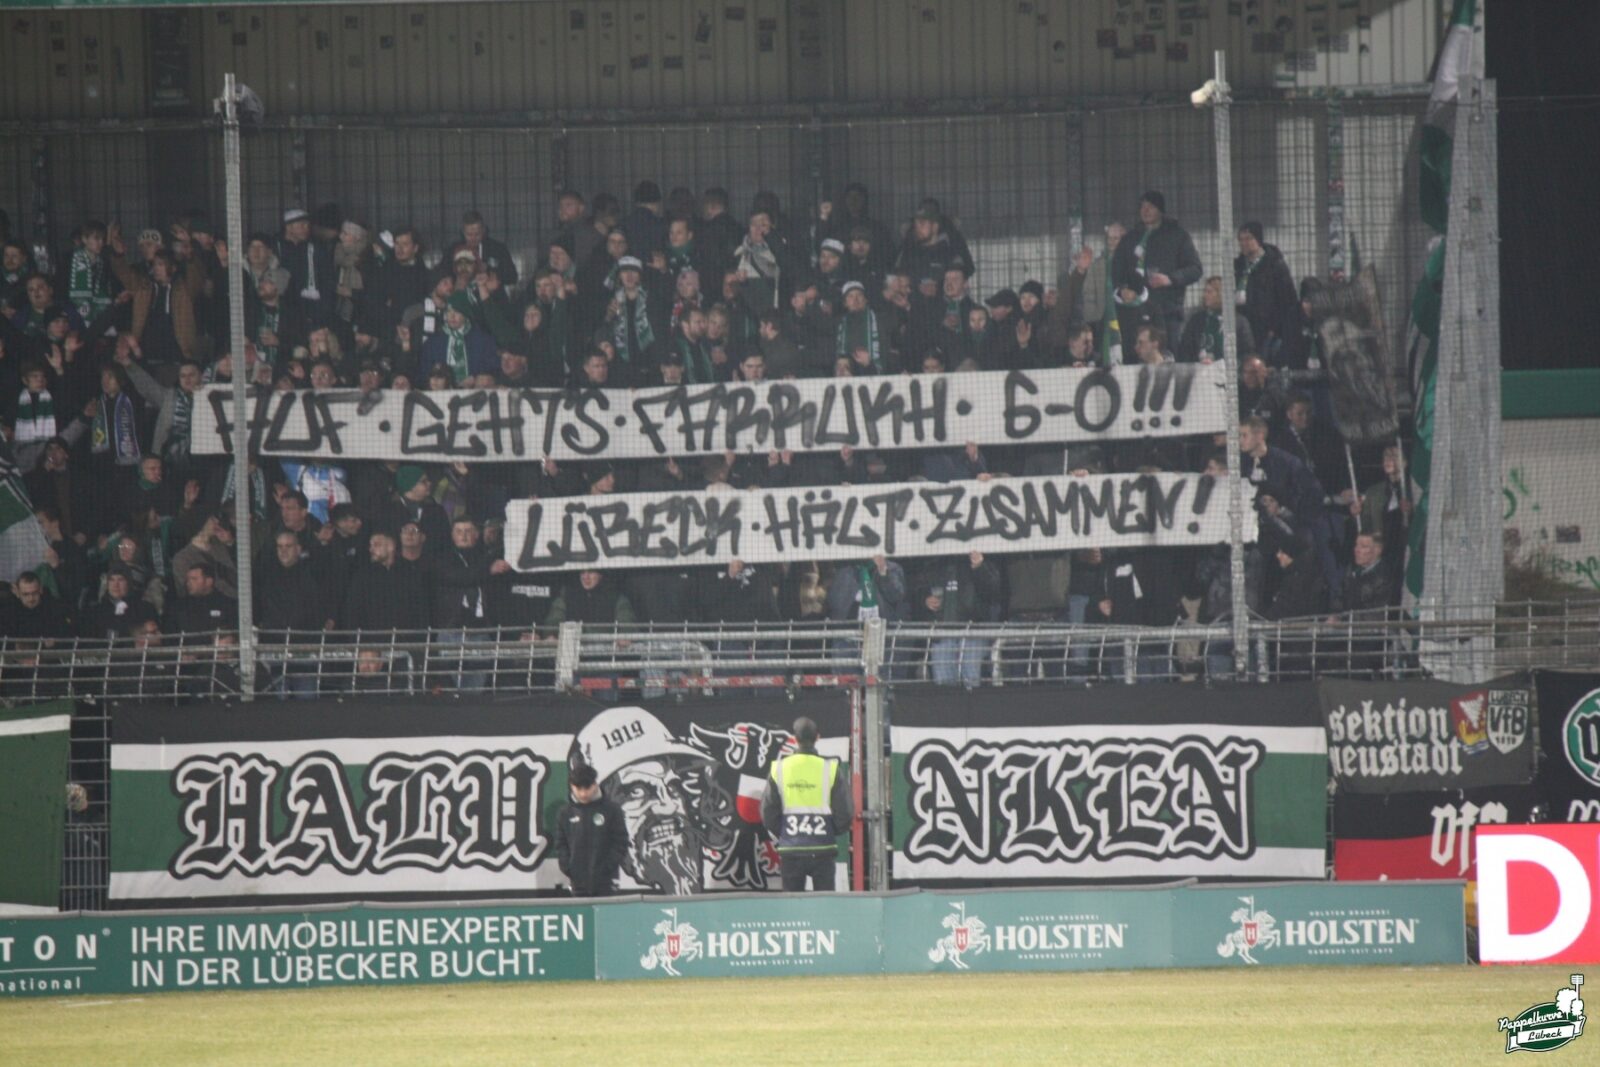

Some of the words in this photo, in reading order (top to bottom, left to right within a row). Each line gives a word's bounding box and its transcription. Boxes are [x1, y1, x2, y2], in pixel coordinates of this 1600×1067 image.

[401, 388, 611, 457] GEHTS
[518, 496, 741, 568] LÜBECK
[765, 489, 914, 553] HÄLT
[601, 719, 645, 751] 1919
[1328, 698, 1449, 743] sektion
[1490, 706, 1525, 735] VfB
[785, 815, 827, 836] 342
[131, 925, 205, 954] IHRE
[216, 914, 585, 952] IMMOBILIENEXPERTEN
[707, 929, 836, 958] HOLSTEN
[995, 923, 1125, 951] HOLSTEN
[1284, 918, 1415, 946] HOLSTEN
[131, 959, 163, 987] IN
[176, 957, 240, 985] DER
[253, 950, 419, 984] LÜBECKER
[430, 947, 546, 978] BUCHT.
